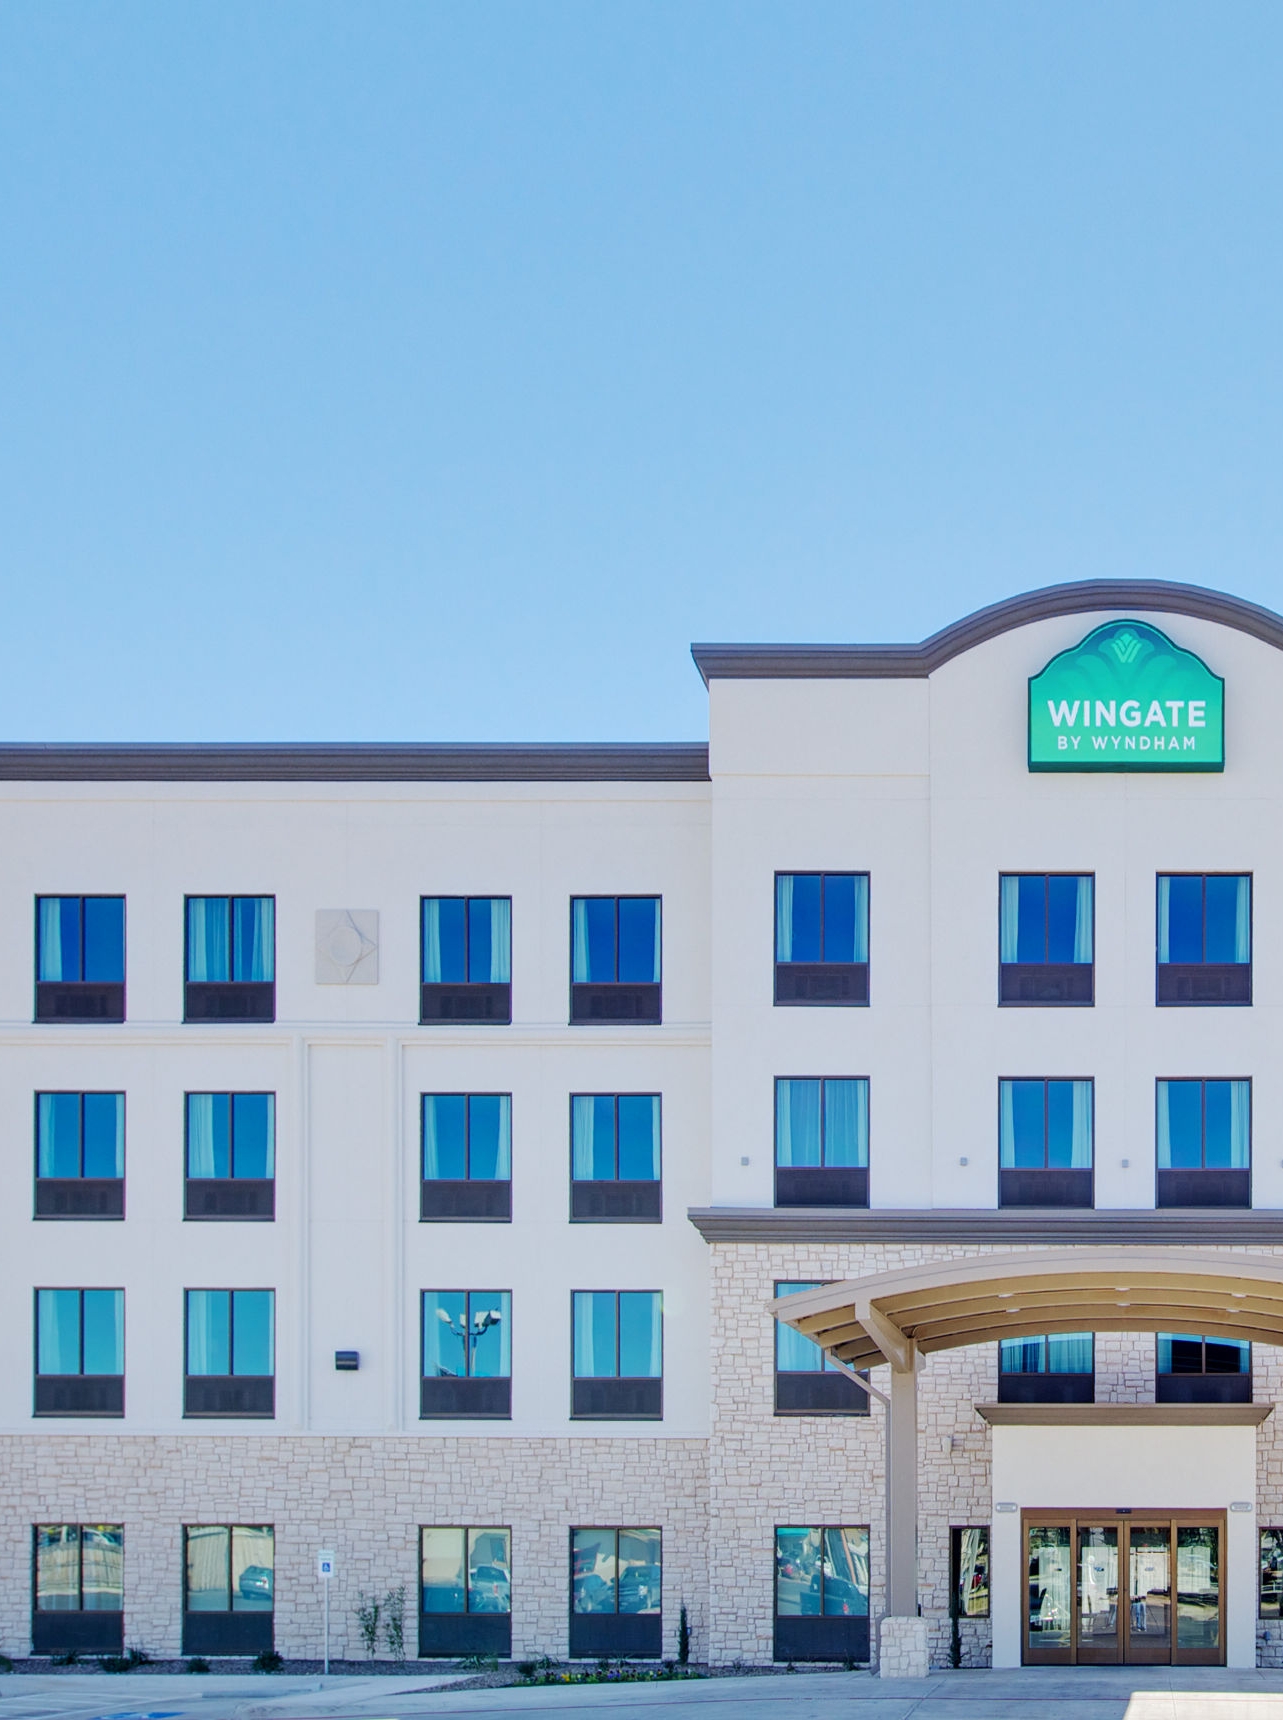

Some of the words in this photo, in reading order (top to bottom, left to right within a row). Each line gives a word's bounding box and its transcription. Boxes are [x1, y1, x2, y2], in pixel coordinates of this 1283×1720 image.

[1047, 700, 1206, 727] WINGATE
[1057, 735, 1081, 750] BY
[1091, 735, 1196, 750] WYNDHAM
